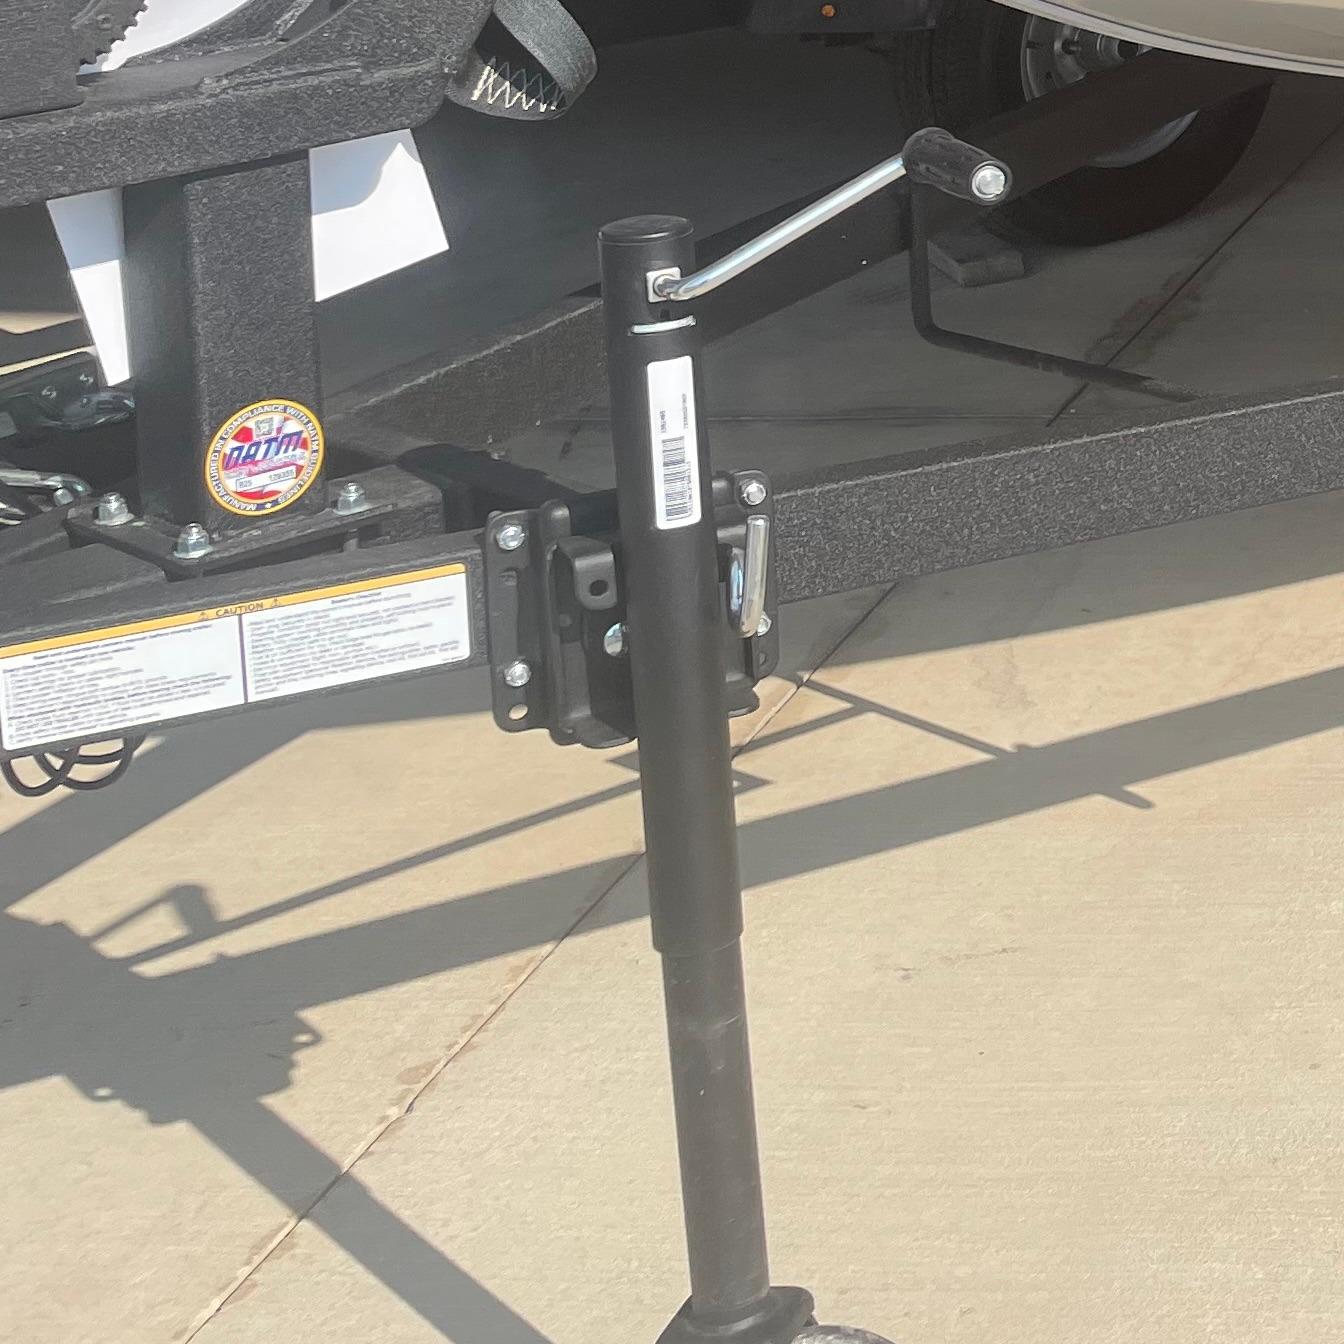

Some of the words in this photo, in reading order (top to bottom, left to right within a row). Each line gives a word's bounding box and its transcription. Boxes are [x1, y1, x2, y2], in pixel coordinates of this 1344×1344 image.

[223, 404, 285, 440] COMPLIANCE
[286, 406, 309, 425] WITH
[210, 452, 257, 511] MANUFACTURED
[215, 601, 265, 617] CAUTION
